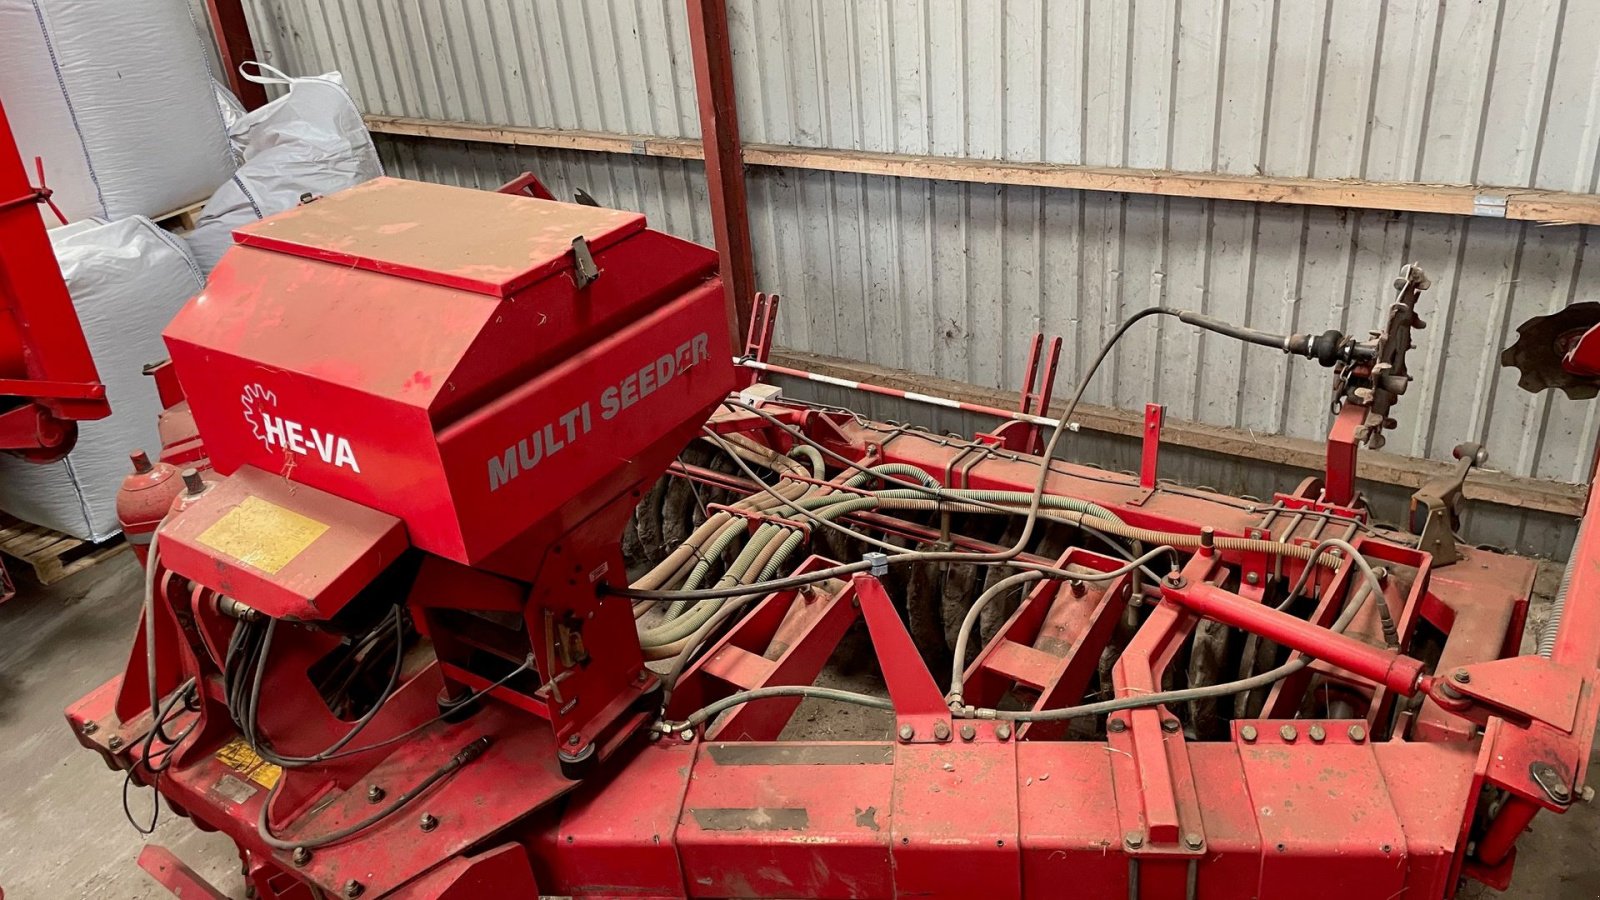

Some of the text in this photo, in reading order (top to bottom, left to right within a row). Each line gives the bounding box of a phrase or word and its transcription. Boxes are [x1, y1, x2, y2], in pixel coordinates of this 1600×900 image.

[262, 412, 360, 474] HE-VA
[487, 332, 709, 492] MULTI SEEDER
